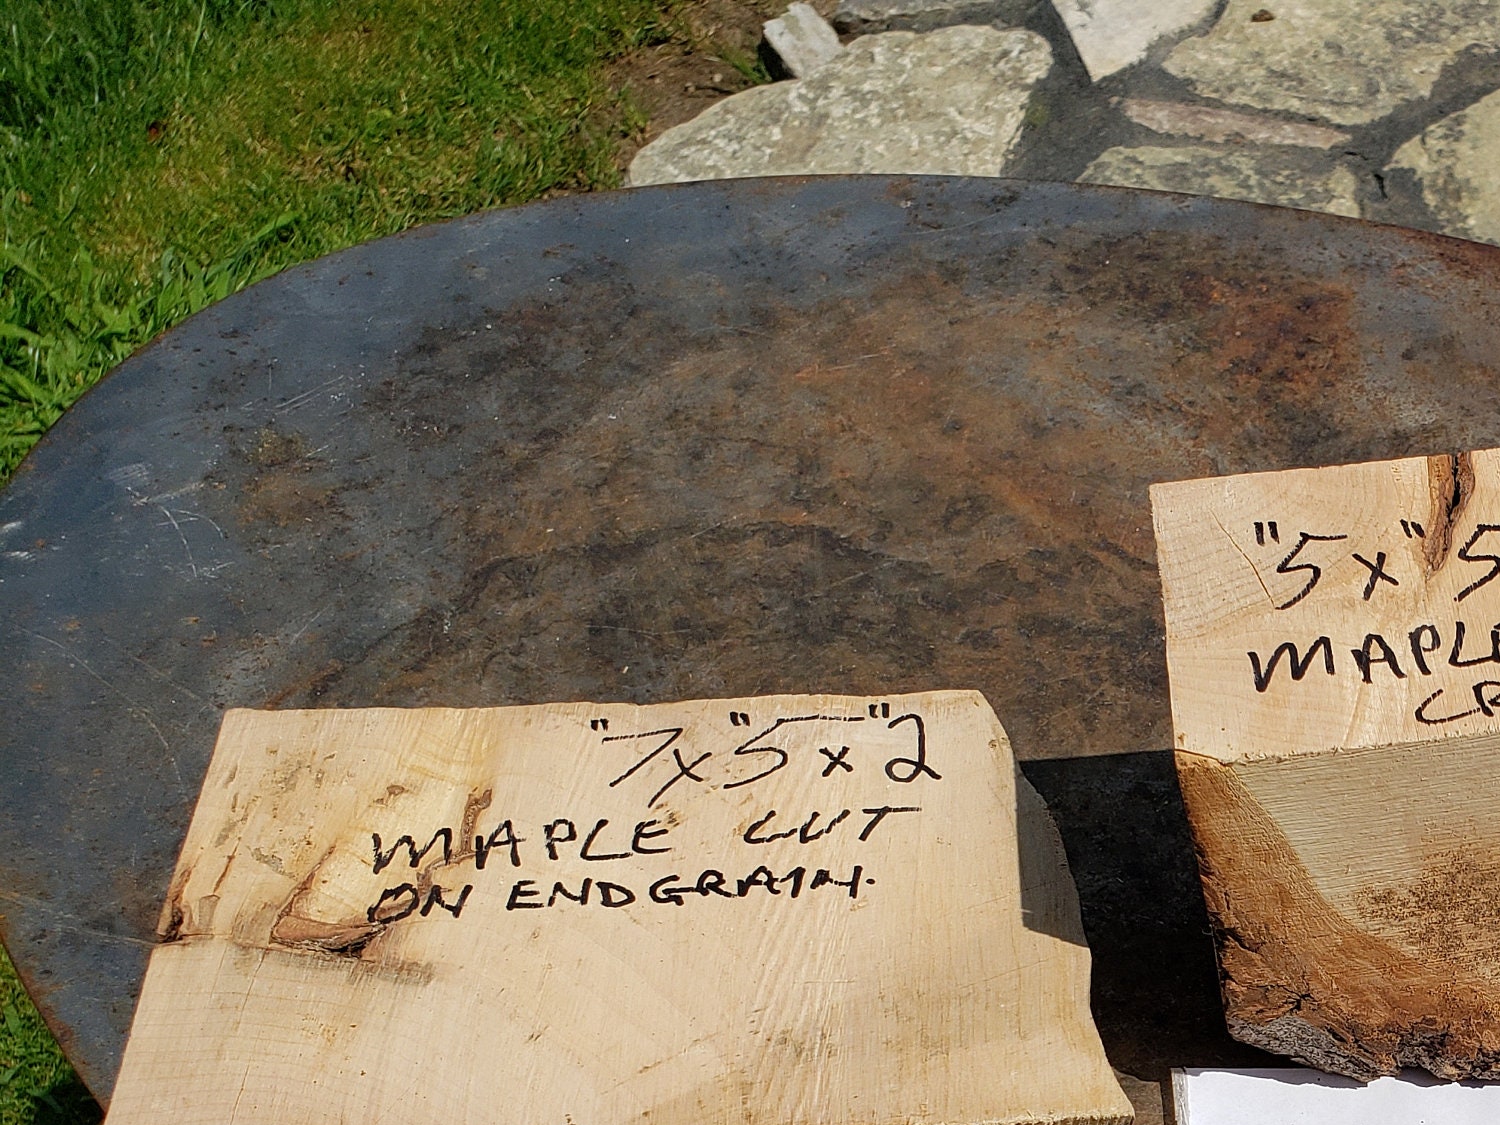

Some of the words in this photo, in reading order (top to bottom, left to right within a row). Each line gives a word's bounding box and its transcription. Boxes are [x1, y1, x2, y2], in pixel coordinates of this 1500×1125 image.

[371, 817, 673, 875] MAPLE
[744, 806, 923, 844] CUT
[367, 882, 474, 925] ON
